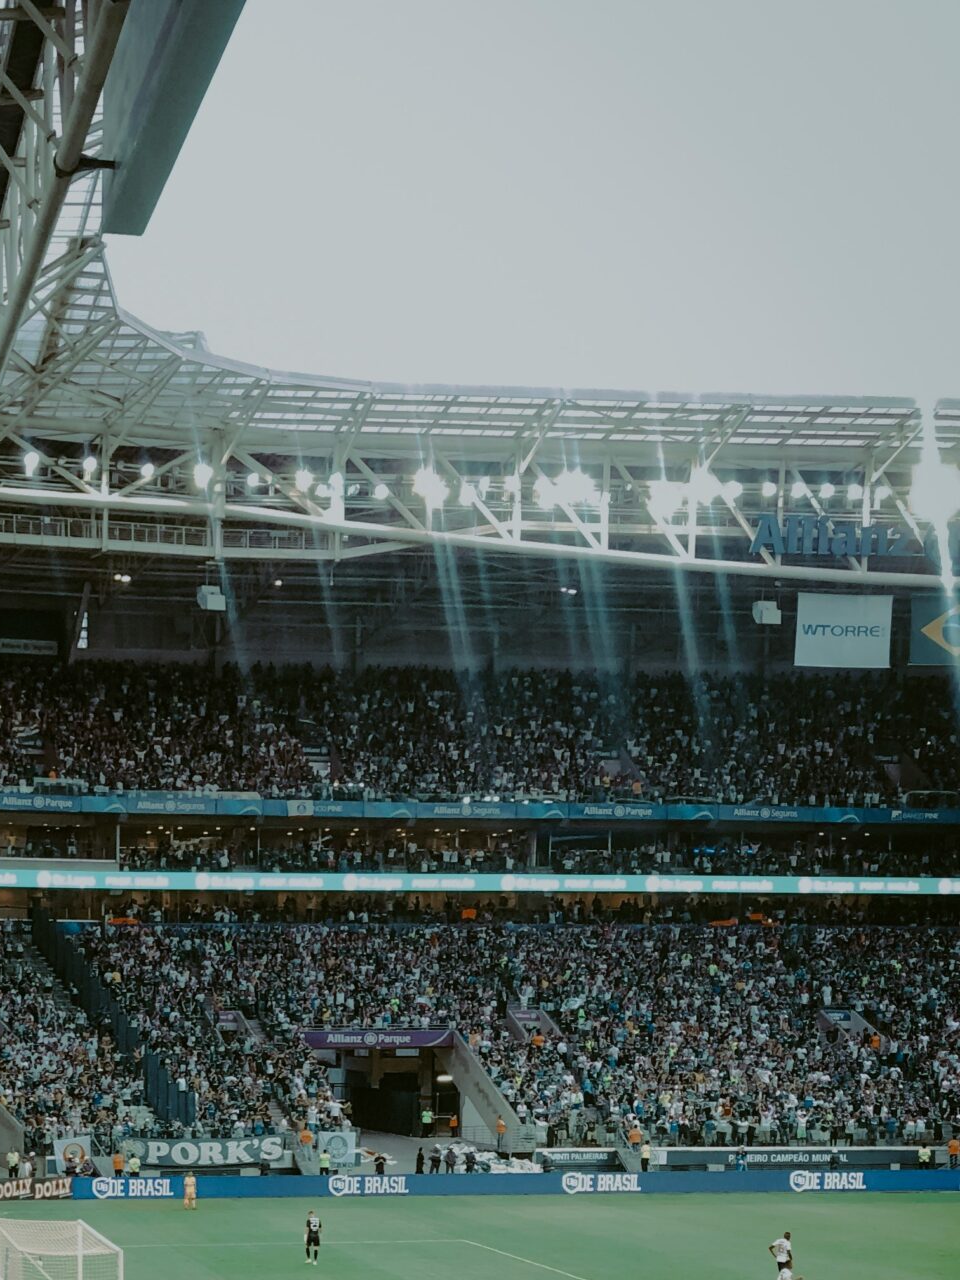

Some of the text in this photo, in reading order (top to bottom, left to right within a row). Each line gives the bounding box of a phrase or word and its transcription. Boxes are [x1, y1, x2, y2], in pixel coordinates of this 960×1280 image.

[749, 516, 912, 557] Allianz
[802, 624, 881, 637] WTORRE
[2, 796, 73, 810] Allianz Parque
[137, 801, 205, 812] Allianz Seguros
[434, 806, 501, 817] Allianz Seguros
[583, 806, 653, 817] Allianz Parque
[733, 808, 798, 820] Allianz Seguros
[327, 1033, 411, 1045] Allianz Parque
[145, 1137, 282, 1165] PORK'S
[768, 1152, 806, 1163] CAMPEÃO
[110, 1177, 125, 1197] DE
[128, 1177, 174, 1197] BRASIL
[345, 1177, 361, 1194] DE
[365, 1176, 409, 1194] BRASIL
[579, 1175, 594, 1192] DE
[597, 1174, 642, 1192] BRASIL
[806, 1172, 821, 1190] DE
[824, 1172, 867, 1190] BRASIL
[35, 1178, 72, 1199] DOLLY
